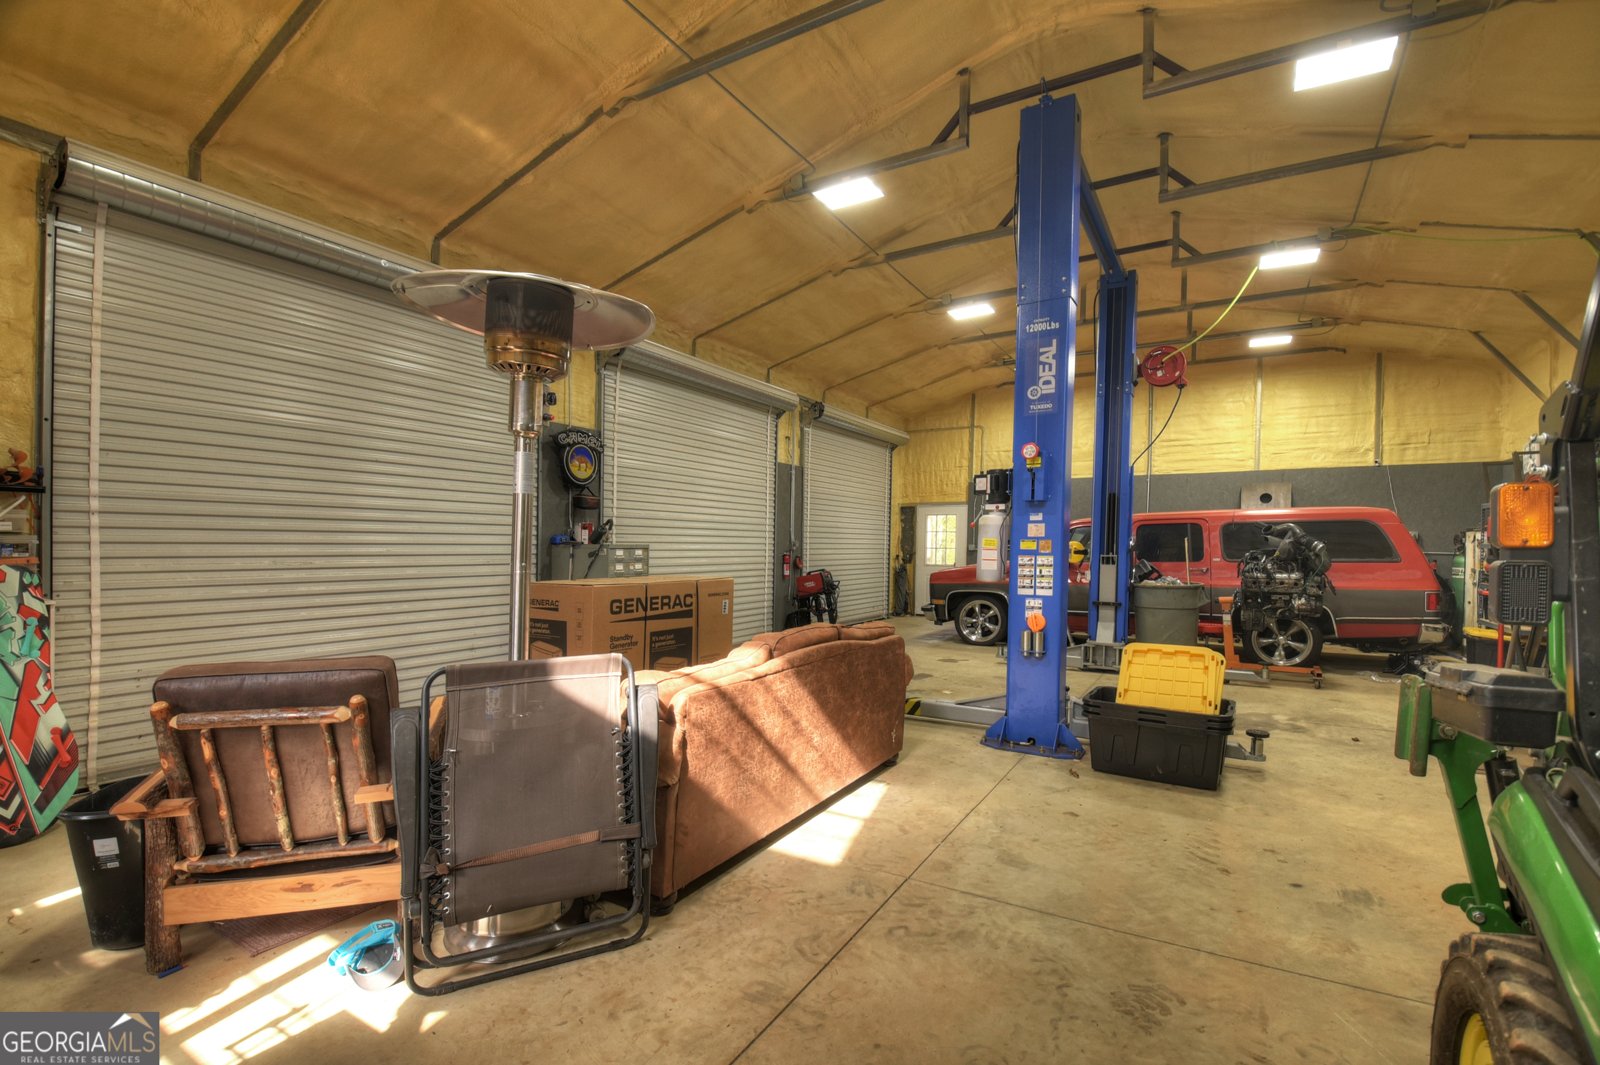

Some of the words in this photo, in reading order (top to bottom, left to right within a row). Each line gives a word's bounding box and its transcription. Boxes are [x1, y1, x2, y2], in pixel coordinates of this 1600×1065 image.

[1037, 338, 1057, 396] IDEAL
[1029, 403, 1053, 411] TUXEDO
[558, 432, 603, 452] CAMEL
[609, 593, 694, 616] GENERAC
[609, 633, 634, 643] Standby
[609, 641, 639, 650] Generator
